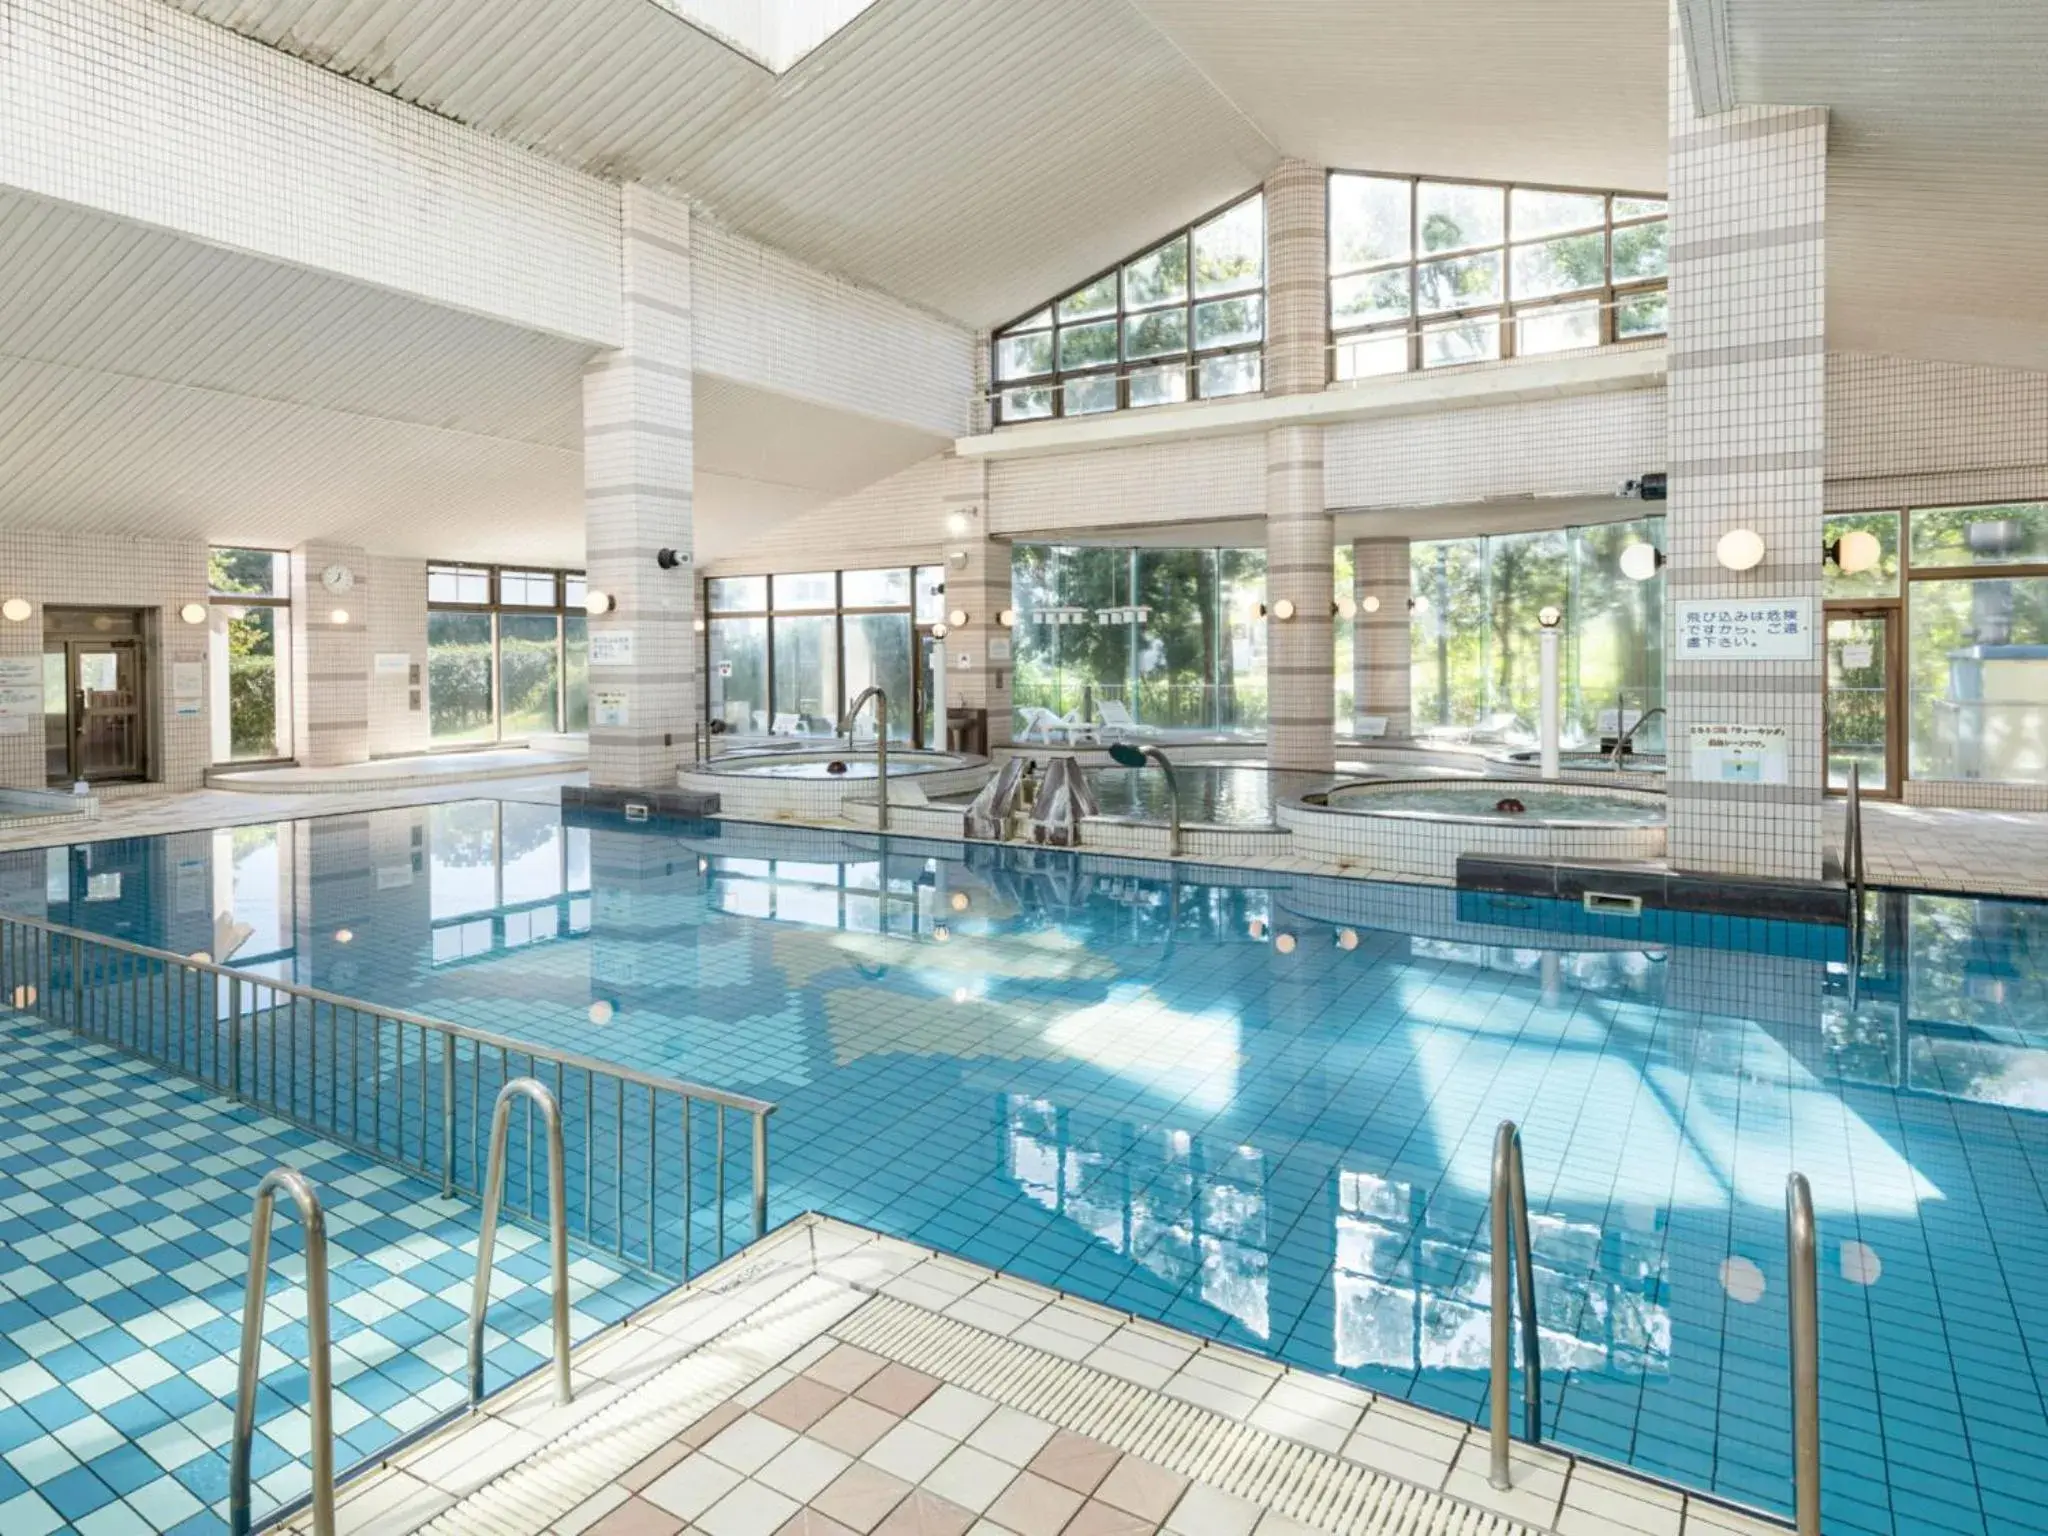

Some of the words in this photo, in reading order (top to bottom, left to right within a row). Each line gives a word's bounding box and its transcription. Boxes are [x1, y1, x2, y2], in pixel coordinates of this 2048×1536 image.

[1687, 609, 1797, 622] 飛び込みは危険
